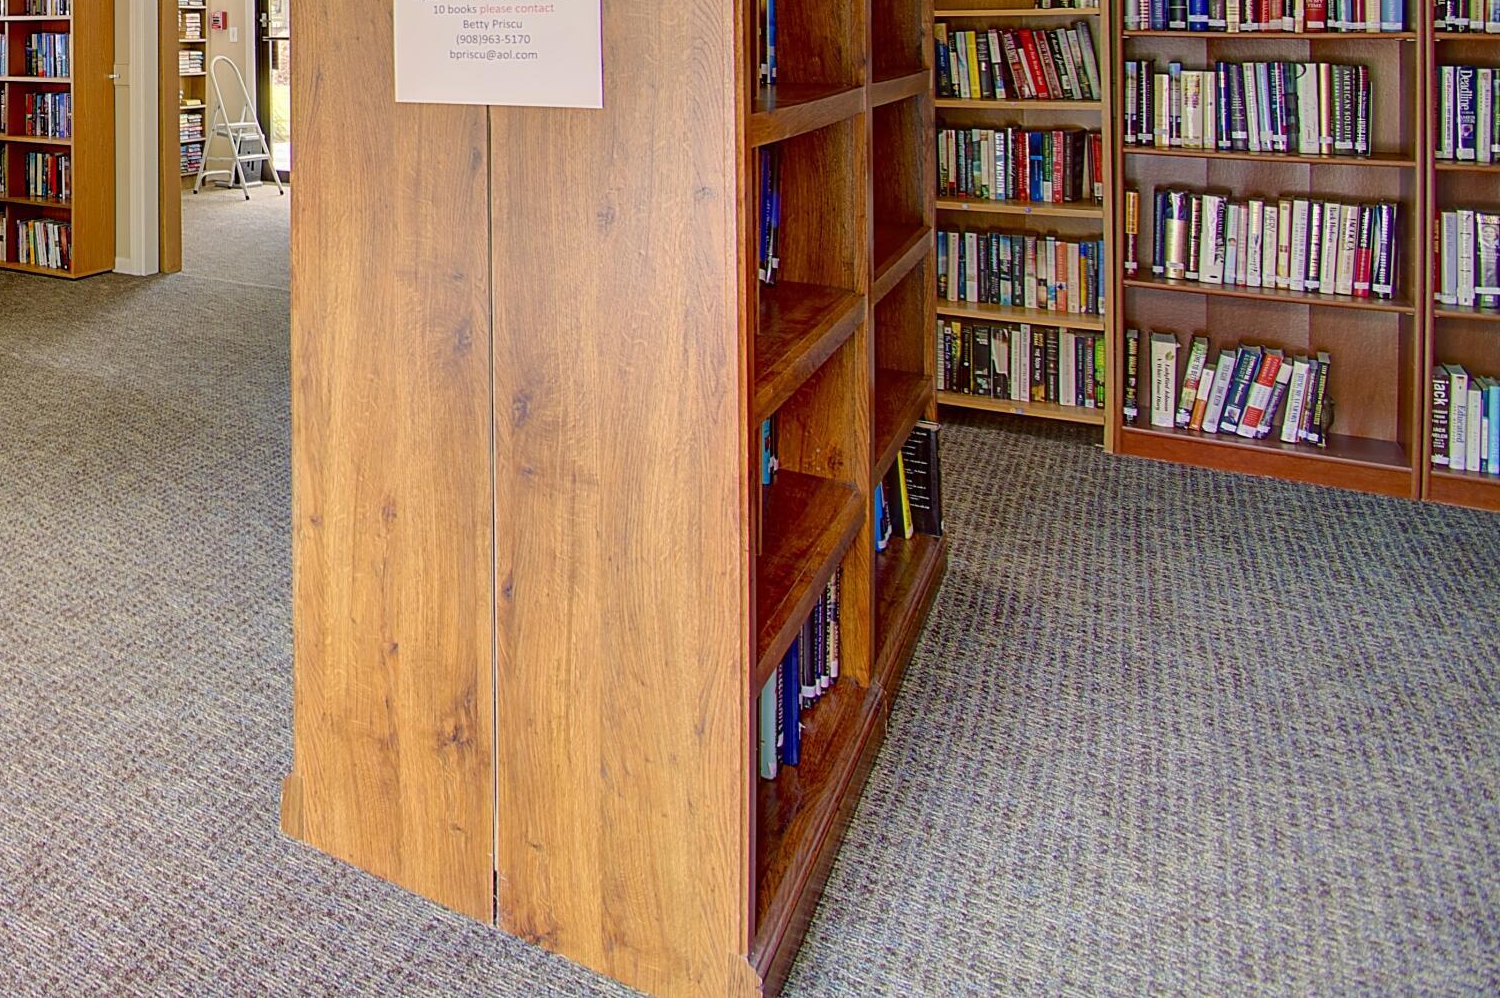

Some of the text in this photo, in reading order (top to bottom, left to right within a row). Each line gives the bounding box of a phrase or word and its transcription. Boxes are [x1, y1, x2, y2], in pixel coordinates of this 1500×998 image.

[433, 3, 555, 16] 10 books please contact
[1154, 3, 1163, 18] BUSH
[462, 19, 523, 30] Betty Priscu
[456, 34, 531, 45] (908)963-5170
[449, 49, 538, 61] bpriscu@aol.com
[1343, 69, 1351, 109] AMERICAN
[1459, 69, 1474, 111] Deadline
[995, 133, 1005, 194] DANA VACHON
[1328, 207, 1337, 243] Rock Hudson
[1034, 357, 1042, 370] BOOK
[1432, 379, 1450, 407] jack
[1455, 404, 1467, 444] Educated
